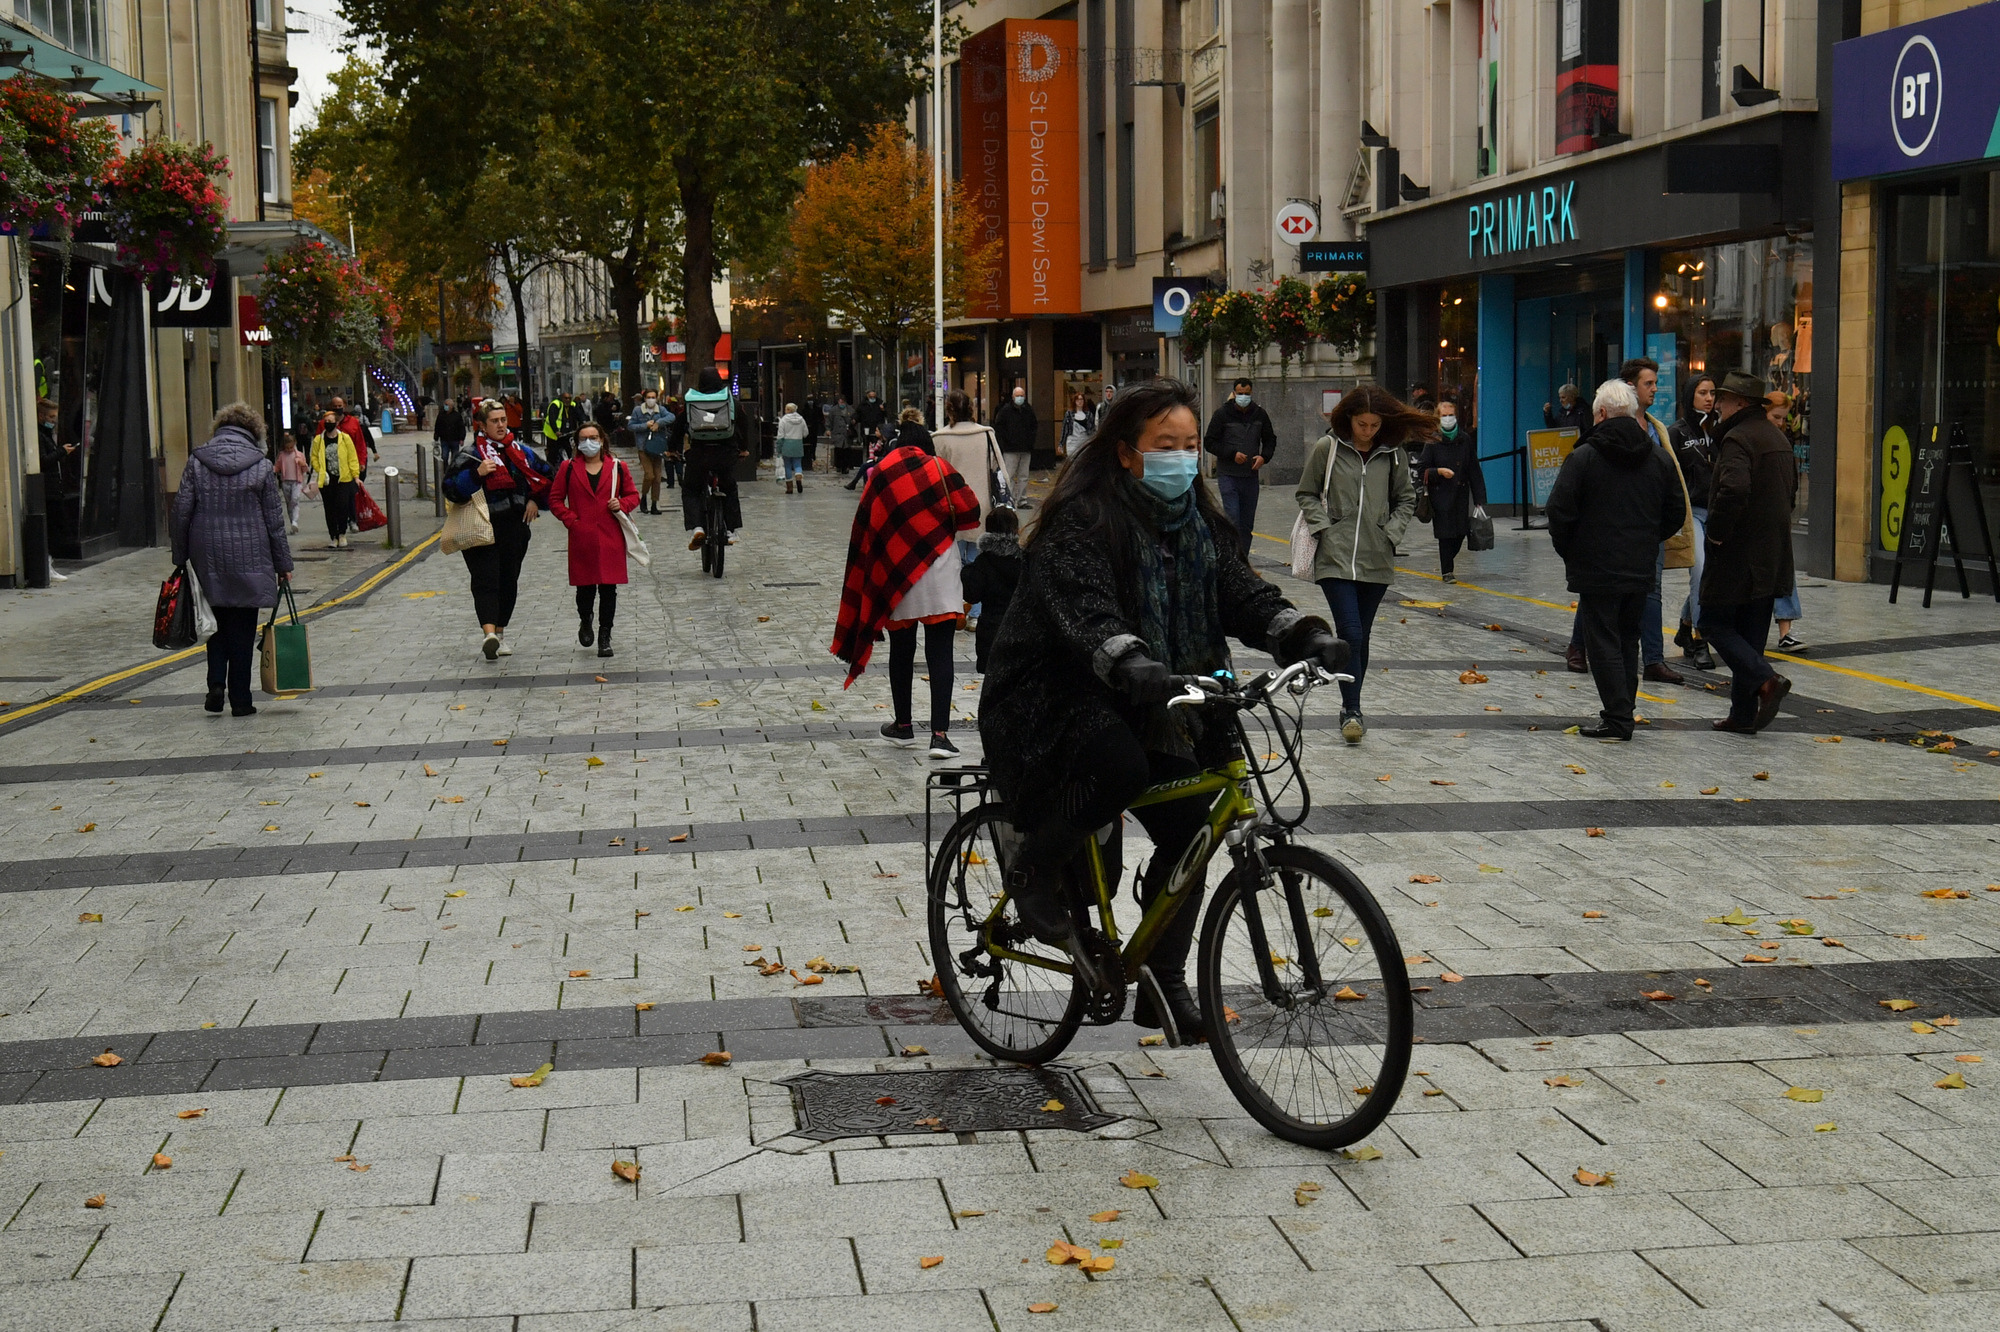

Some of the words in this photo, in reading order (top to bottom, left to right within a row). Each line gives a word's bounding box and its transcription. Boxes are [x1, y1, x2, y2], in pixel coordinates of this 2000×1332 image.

[1029, 90, 1048, 114] St
[1902, 72, 1931, 119] BT
[1030, 120, 1050, 196] David's
[984, 215, 1001, 262] Dei
[1031, 201, 1050, 253] Dewi
[1468, 180, 1576, 259] PRIMARK
[1306, 251, 1364, 261] PRIMARK
[1032, 257, 1051, 305] Sant
[1135, 320, 1154, 328] ERN
[1534, 446, 1560, 457] NEW
